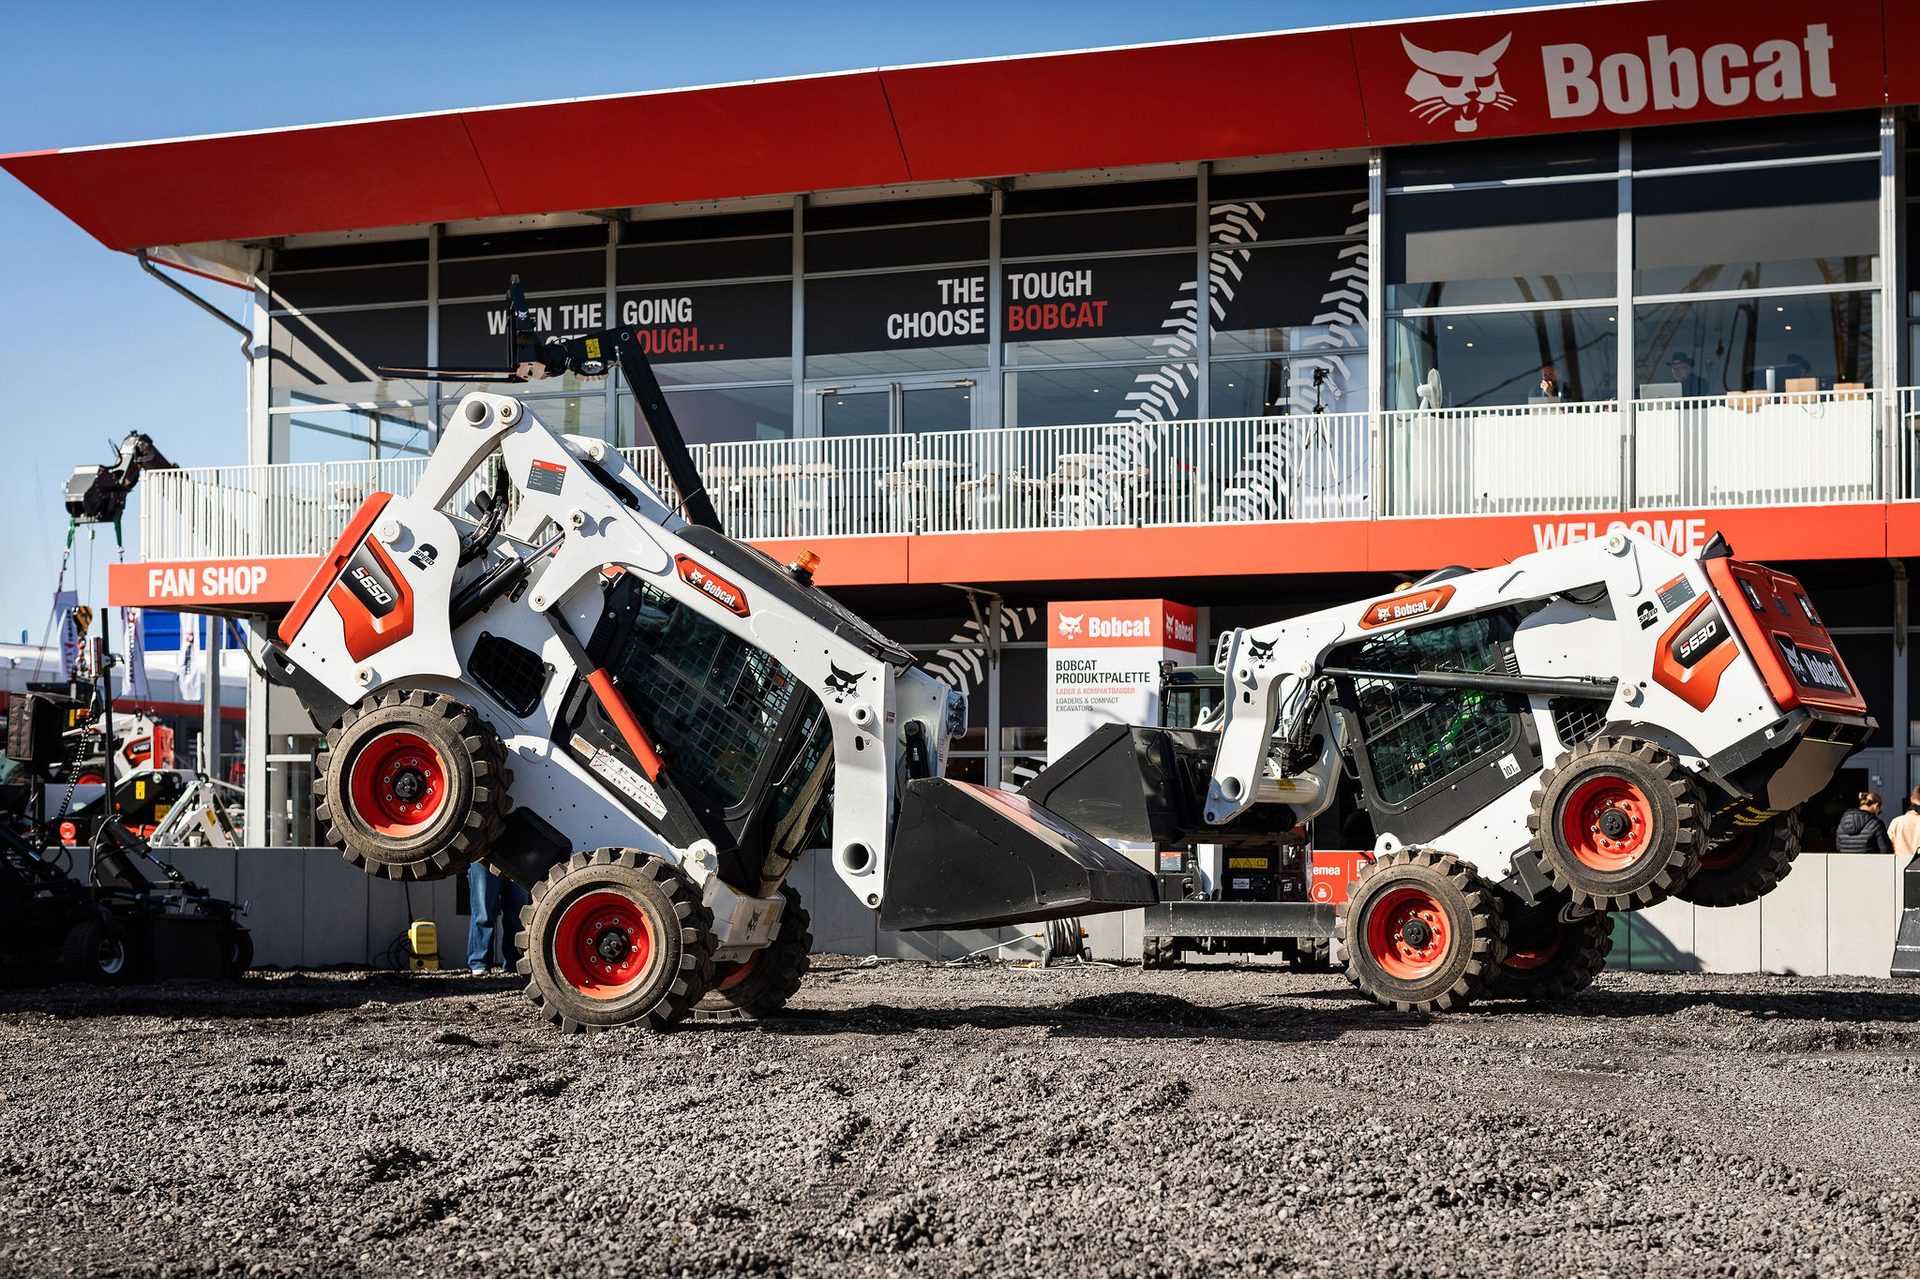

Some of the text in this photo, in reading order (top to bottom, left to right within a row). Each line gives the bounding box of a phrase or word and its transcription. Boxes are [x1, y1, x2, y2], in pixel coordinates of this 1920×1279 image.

[1541, 23, 1837, 119] Bobcat
[937, 270, 1092, 305] THE TOUGH
[559, 303, 602, 330] THE
[623, 297, 693, 326] GOING
[886, 300, 1108, 340] CHOOSE BOBCAT
[636, 327, 725, 354] OUGH...
[413, 550, 434, 566] SPEED
[148, 566, 267, 598] FAN SHOP
[351, 567, 392, 605] S650
[1088, 616, 1151, 638] Bobcat
[1638, 608, 1658, 623] SPEED
[1174, 619, 1194, 643] Bobcat
[1679, 620, 1717, 659] S630
[1056, 660, 1097, 671] BOBCAT
[1056, 672, 1151, 684] PRODUKTPALETTE
[1801, 653, 1846, 688] Bobcat
[1056, 697, 1083, 705] LOADERS
[1502, 764, 1516, 777] 101
